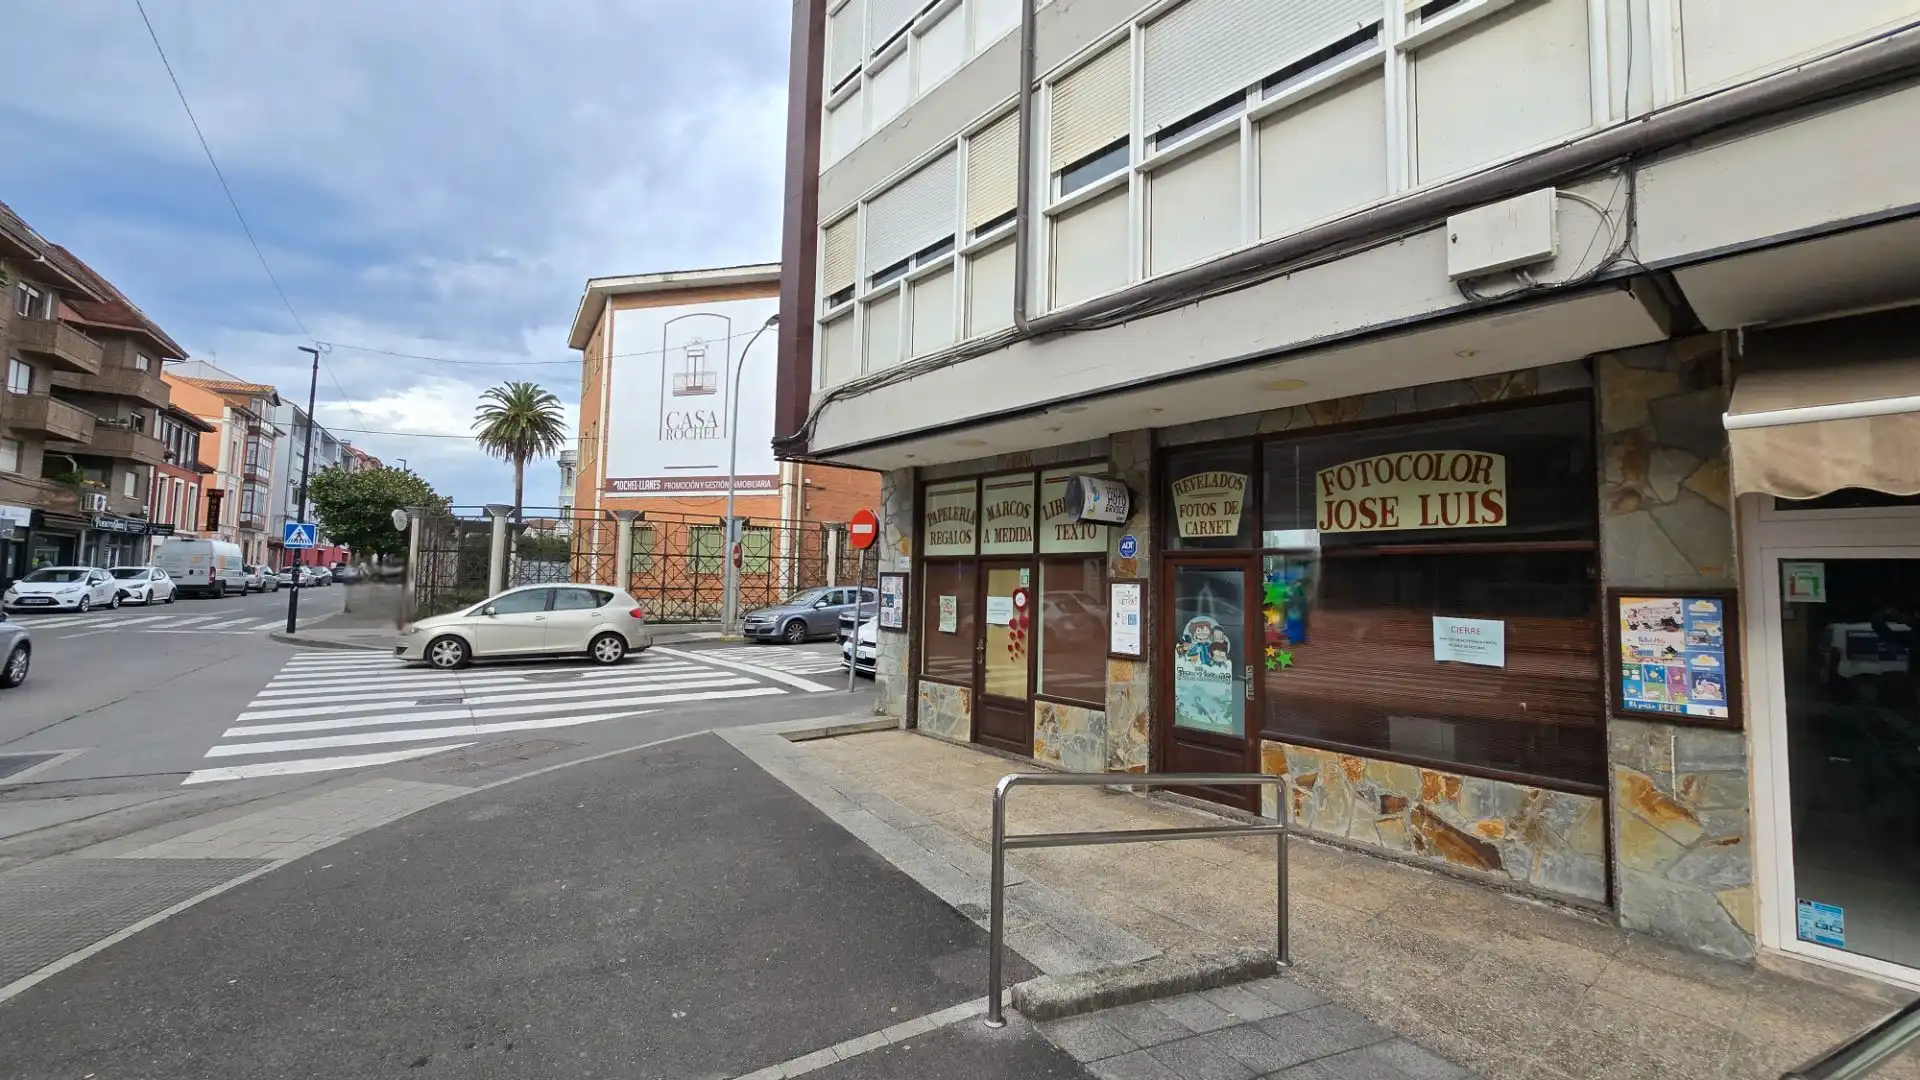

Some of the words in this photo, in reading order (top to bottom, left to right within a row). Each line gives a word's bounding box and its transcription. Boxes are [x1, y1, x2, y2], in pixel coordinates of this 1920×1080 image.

[666, 409, 719, 429] CASA
[666, 426, 719, 440] ROCHEL
[1319, 453, 1494, 497] FOTOCOLOR
[1174, 474, 1245, 496] REVELADOS
[927, 506, 976, 527] PAPELERIA
[986, 500, 1032, 522] MARCOS
[1179, 502, 1217, 518] FOTOS
[1224, 500, 1240, 515] DE
[1319, 496, 1399, 531] JOSE
[1418, 489, 1504, 526] LUIS
[983, 528, 990, 544] A
[994, 526, 1033, 543] MEDIDA
[1055, 523, 1097, 540] TEXTO
[1185, 520, 1231, 536] CARNET
[930, 529, 972, 546] REGALOS
[1121, 541, 1135, 549] ADT
[1450, 626, 1482, 635] CIERRE
